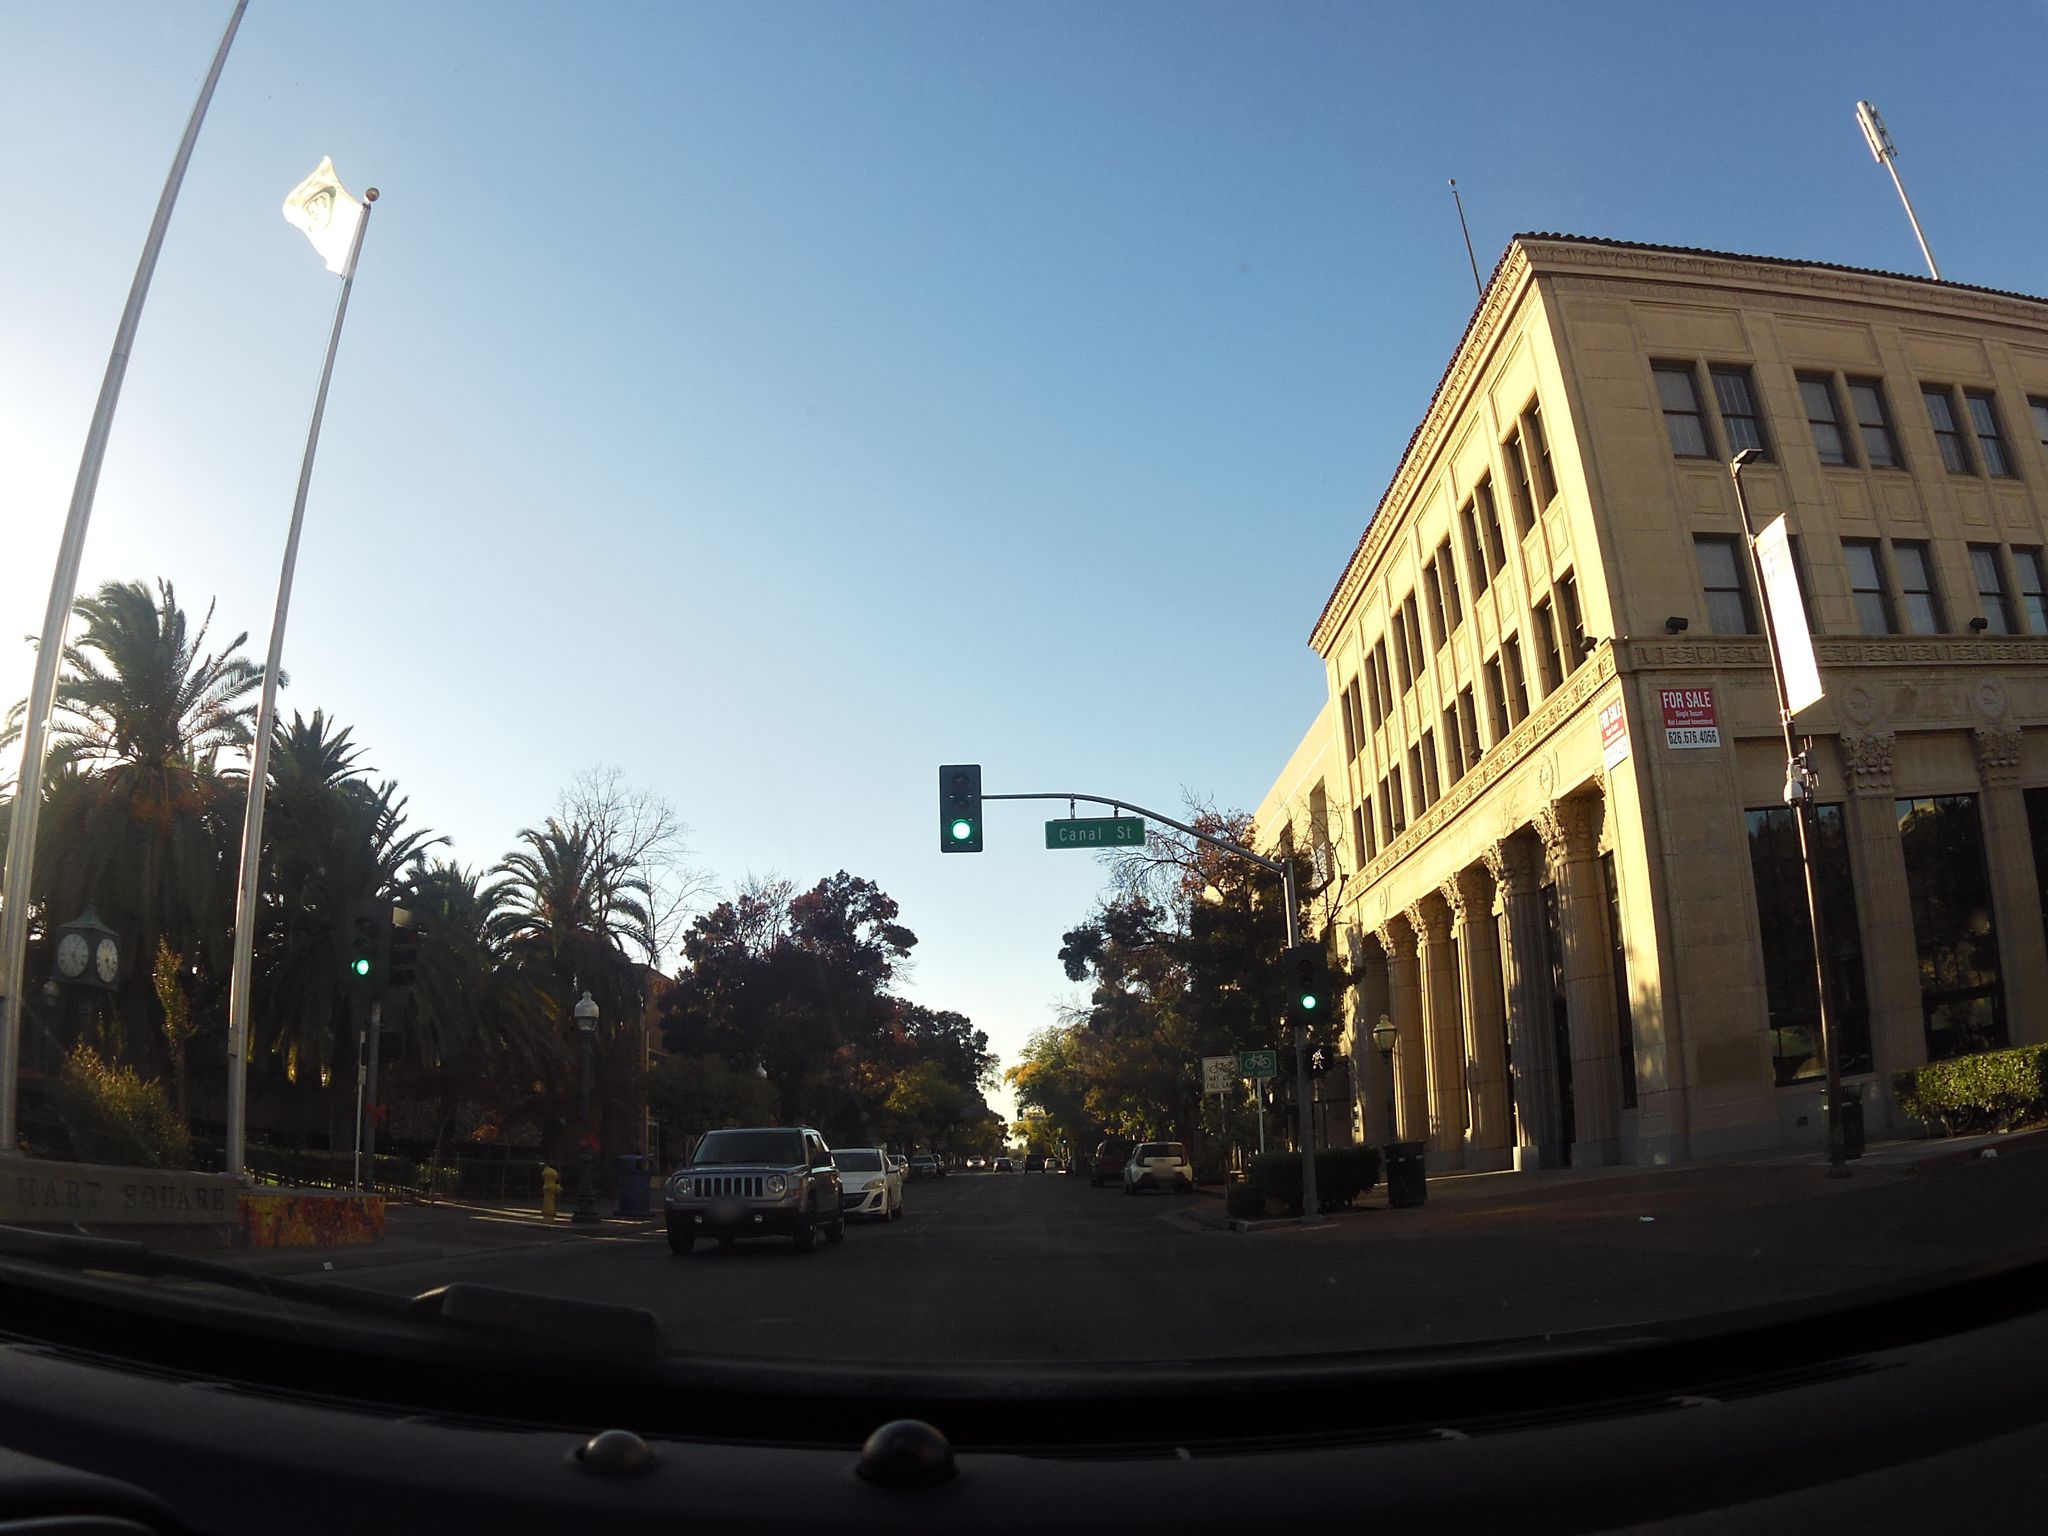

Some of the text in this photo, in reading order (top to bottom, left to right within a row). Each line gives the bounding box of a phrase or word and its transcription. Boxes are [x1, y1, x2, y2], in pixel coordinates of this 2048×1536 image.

[1662, 691, 1712, 709] FOR SALE
[1059, 826, 1132, 841] Canal St
[16, 1177, 225, 1212] HART SQUARE
